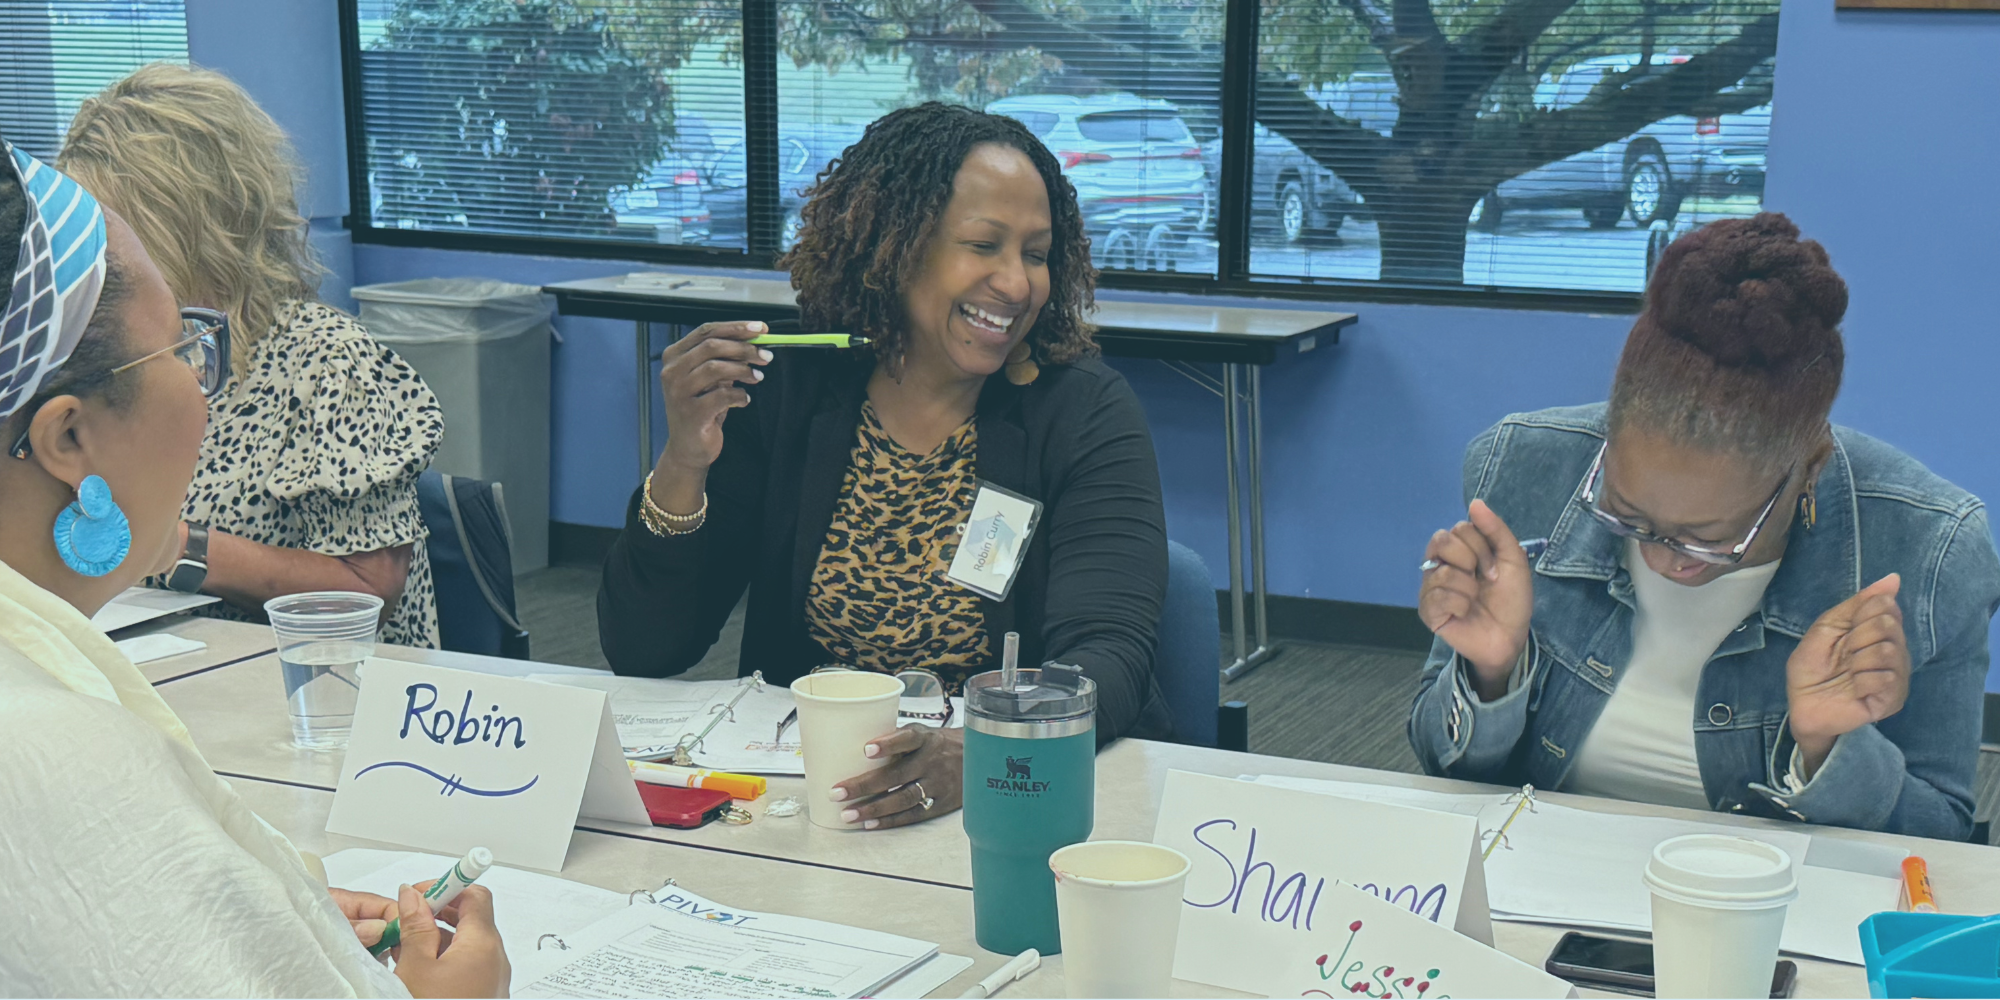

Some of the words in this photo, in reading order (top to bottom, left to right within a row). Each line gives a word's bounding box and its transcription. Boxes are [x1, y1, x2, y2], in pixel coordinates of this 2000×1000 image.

[973, 542, 992, 571] Robin
[986, 511, 1005, 540] Curry
[399, 683, 526, 749] Robin
[986, 777, 1051, 792] STANLEY
